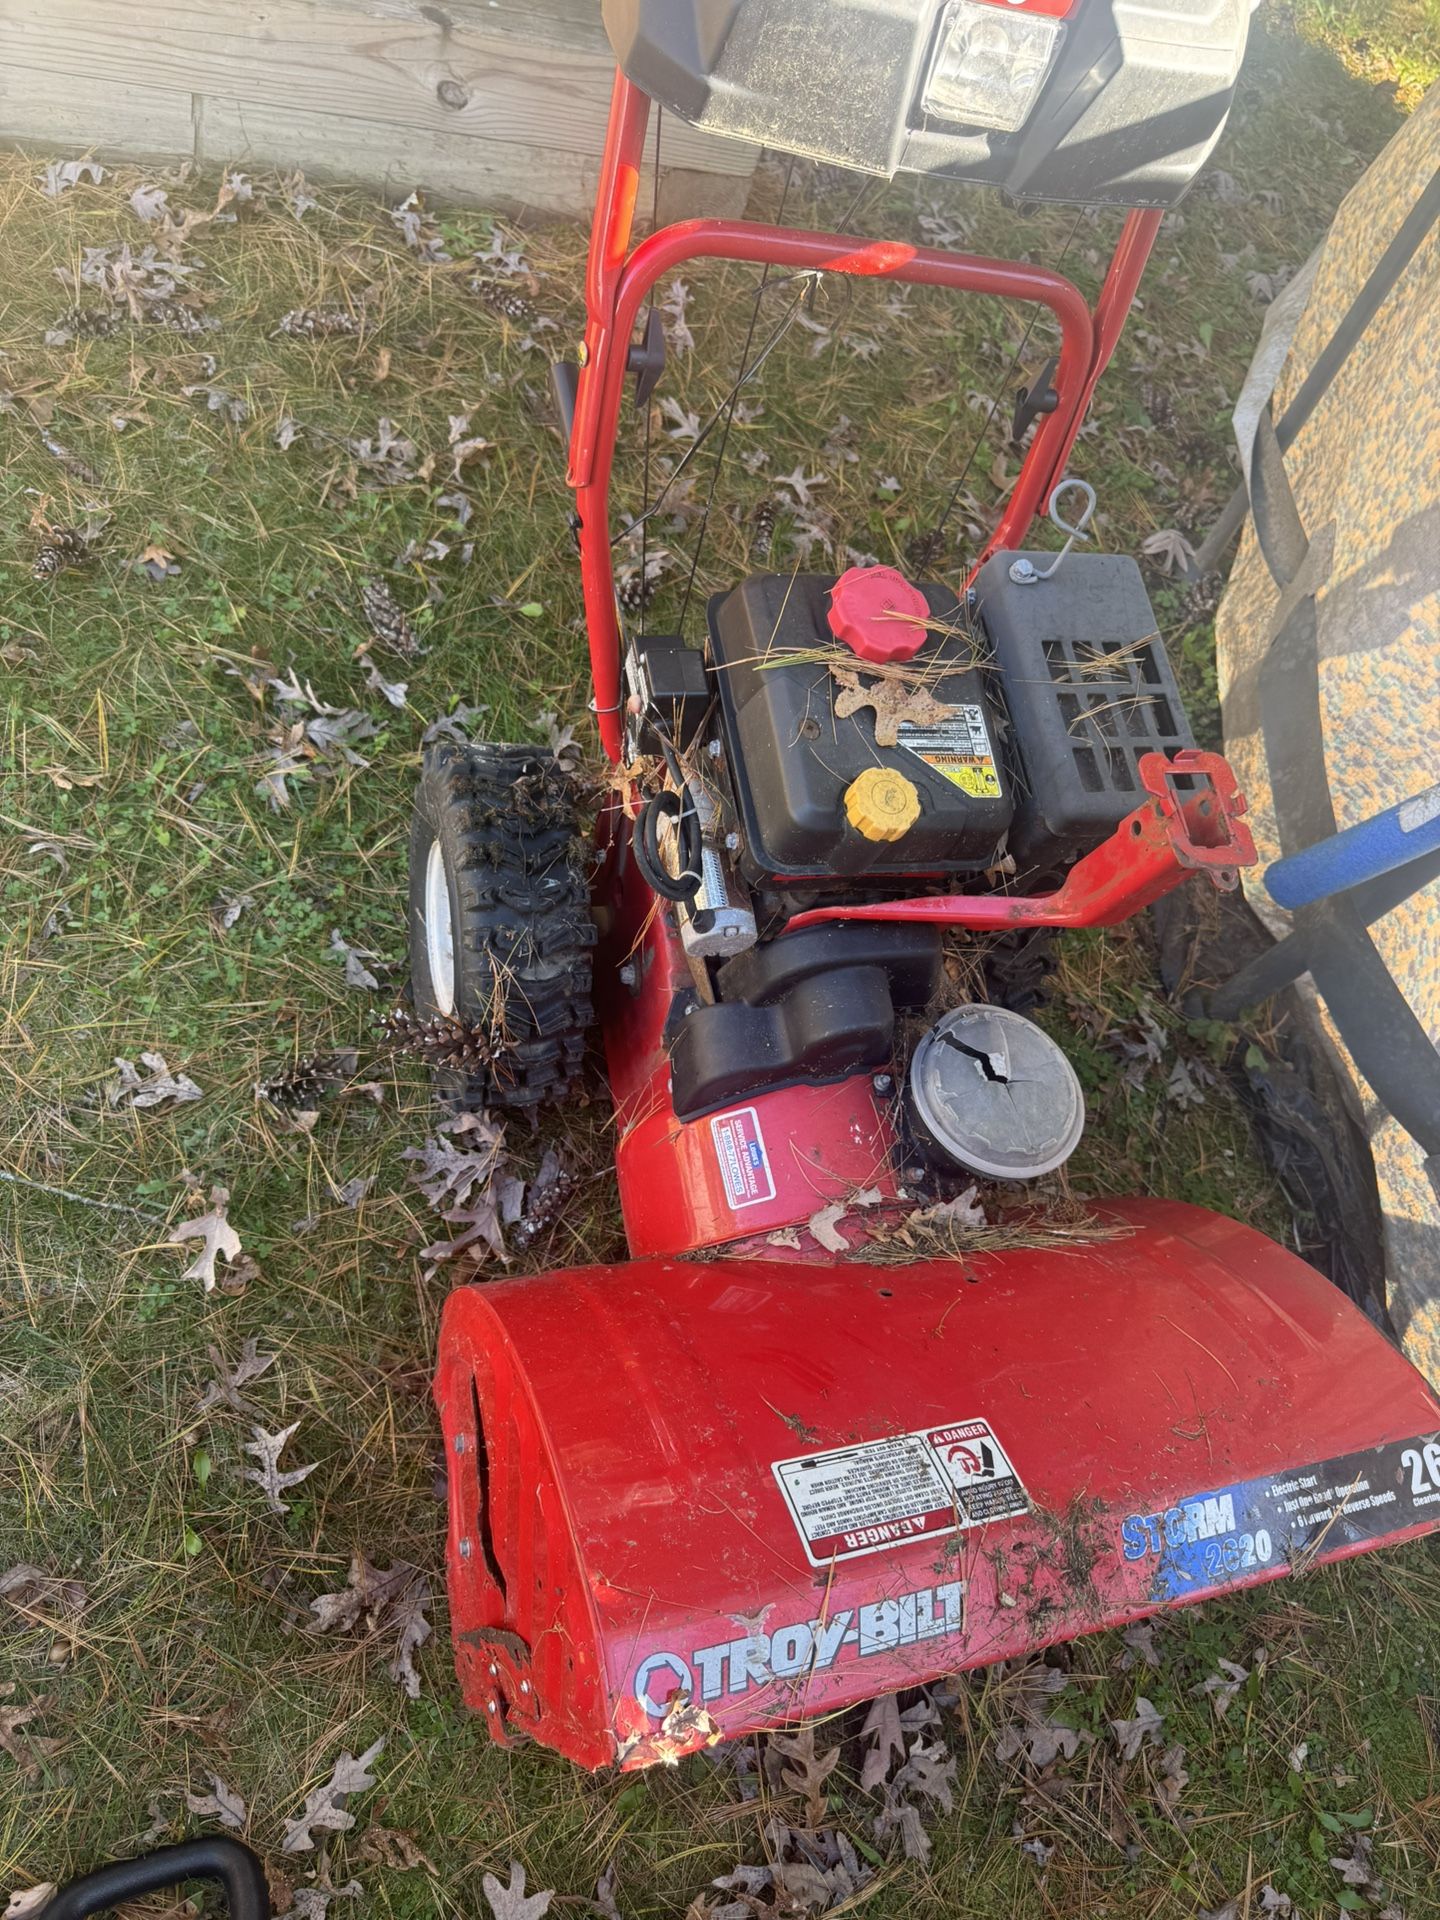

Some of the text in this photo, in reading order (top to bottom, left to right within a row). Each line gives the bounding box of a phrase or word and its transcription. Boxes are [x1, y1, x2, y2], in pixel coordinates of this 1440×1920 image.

[735, 1120, 747, 1150] SERVICE
[742, 1151, 758, 1195] ADVANTAGE
[942, 1424, 986, 1442] DANGER
[901, 1460, 924, 1468] ISCHARGE
[863, 1474, 884, 1483] OECTS
[866, 1480, 892, 1489] SERVICING
[1271, 1475, 1317, 1497] Electric Start
[855, 1490, 871, 1498] PARTS
[895, 1487, 912, 1495] CLUTCH
[821, 1497, 843, 1506] STOPPED
[964, 1492, 994, 1502] RTATING
[802, 1502, 821, 1510] BEFORE
[1283, 1498, 1300, 1513] Just
[1299, 1496, 1312, 1507] One
[1297, 1515, 1304, 1527] 6
[1303, 1508, 1332, 1526] orward
[1342, 1498, 1371, 1514] Reverse
[1370, 1491, 1396, 1507] Speeds
[836, 1517, 853, 1525] HANDS
[853, 1512, 877, 1521] AMPUTATE
[1122, 1493, 1236, 1560] STORM
[810, 1530, 832, 1539] CONTACT
[844, 1519, 914, 1548] DANGER
[1205, 1528, 1273, 1578] 2620
[693, 1581, 964, 1701] TROY-BILT
